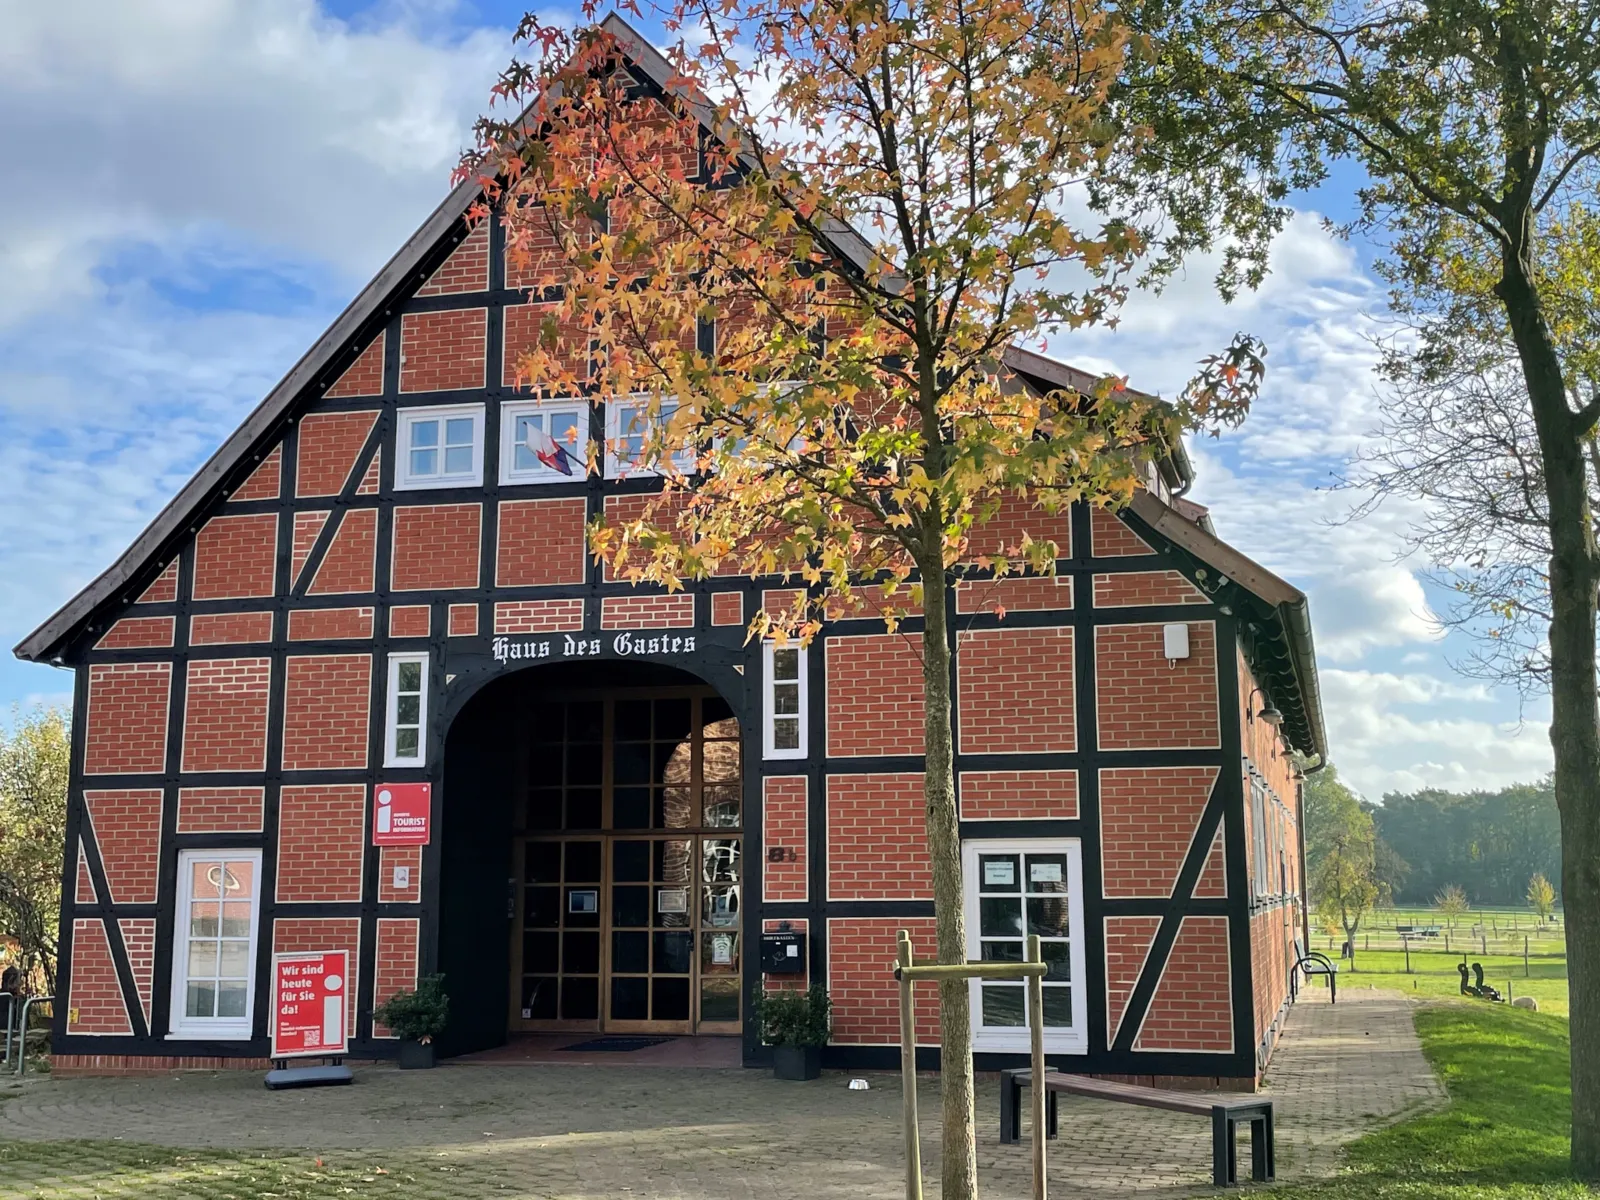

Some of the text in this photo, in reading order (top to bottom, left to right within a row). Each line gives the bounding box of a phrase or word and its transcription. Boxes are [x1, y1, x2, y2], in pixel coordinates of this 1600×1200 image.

[492, 632, 696, 665] Haus des Gastes
[393, 817, 426, 827] TOURIST
[282, 964, 324, 976] Wir sind
[281, 979, 313, 989] heute
[281, 991, 315, 1002] für Sie
[281, 1004, 299, 1015] da!
